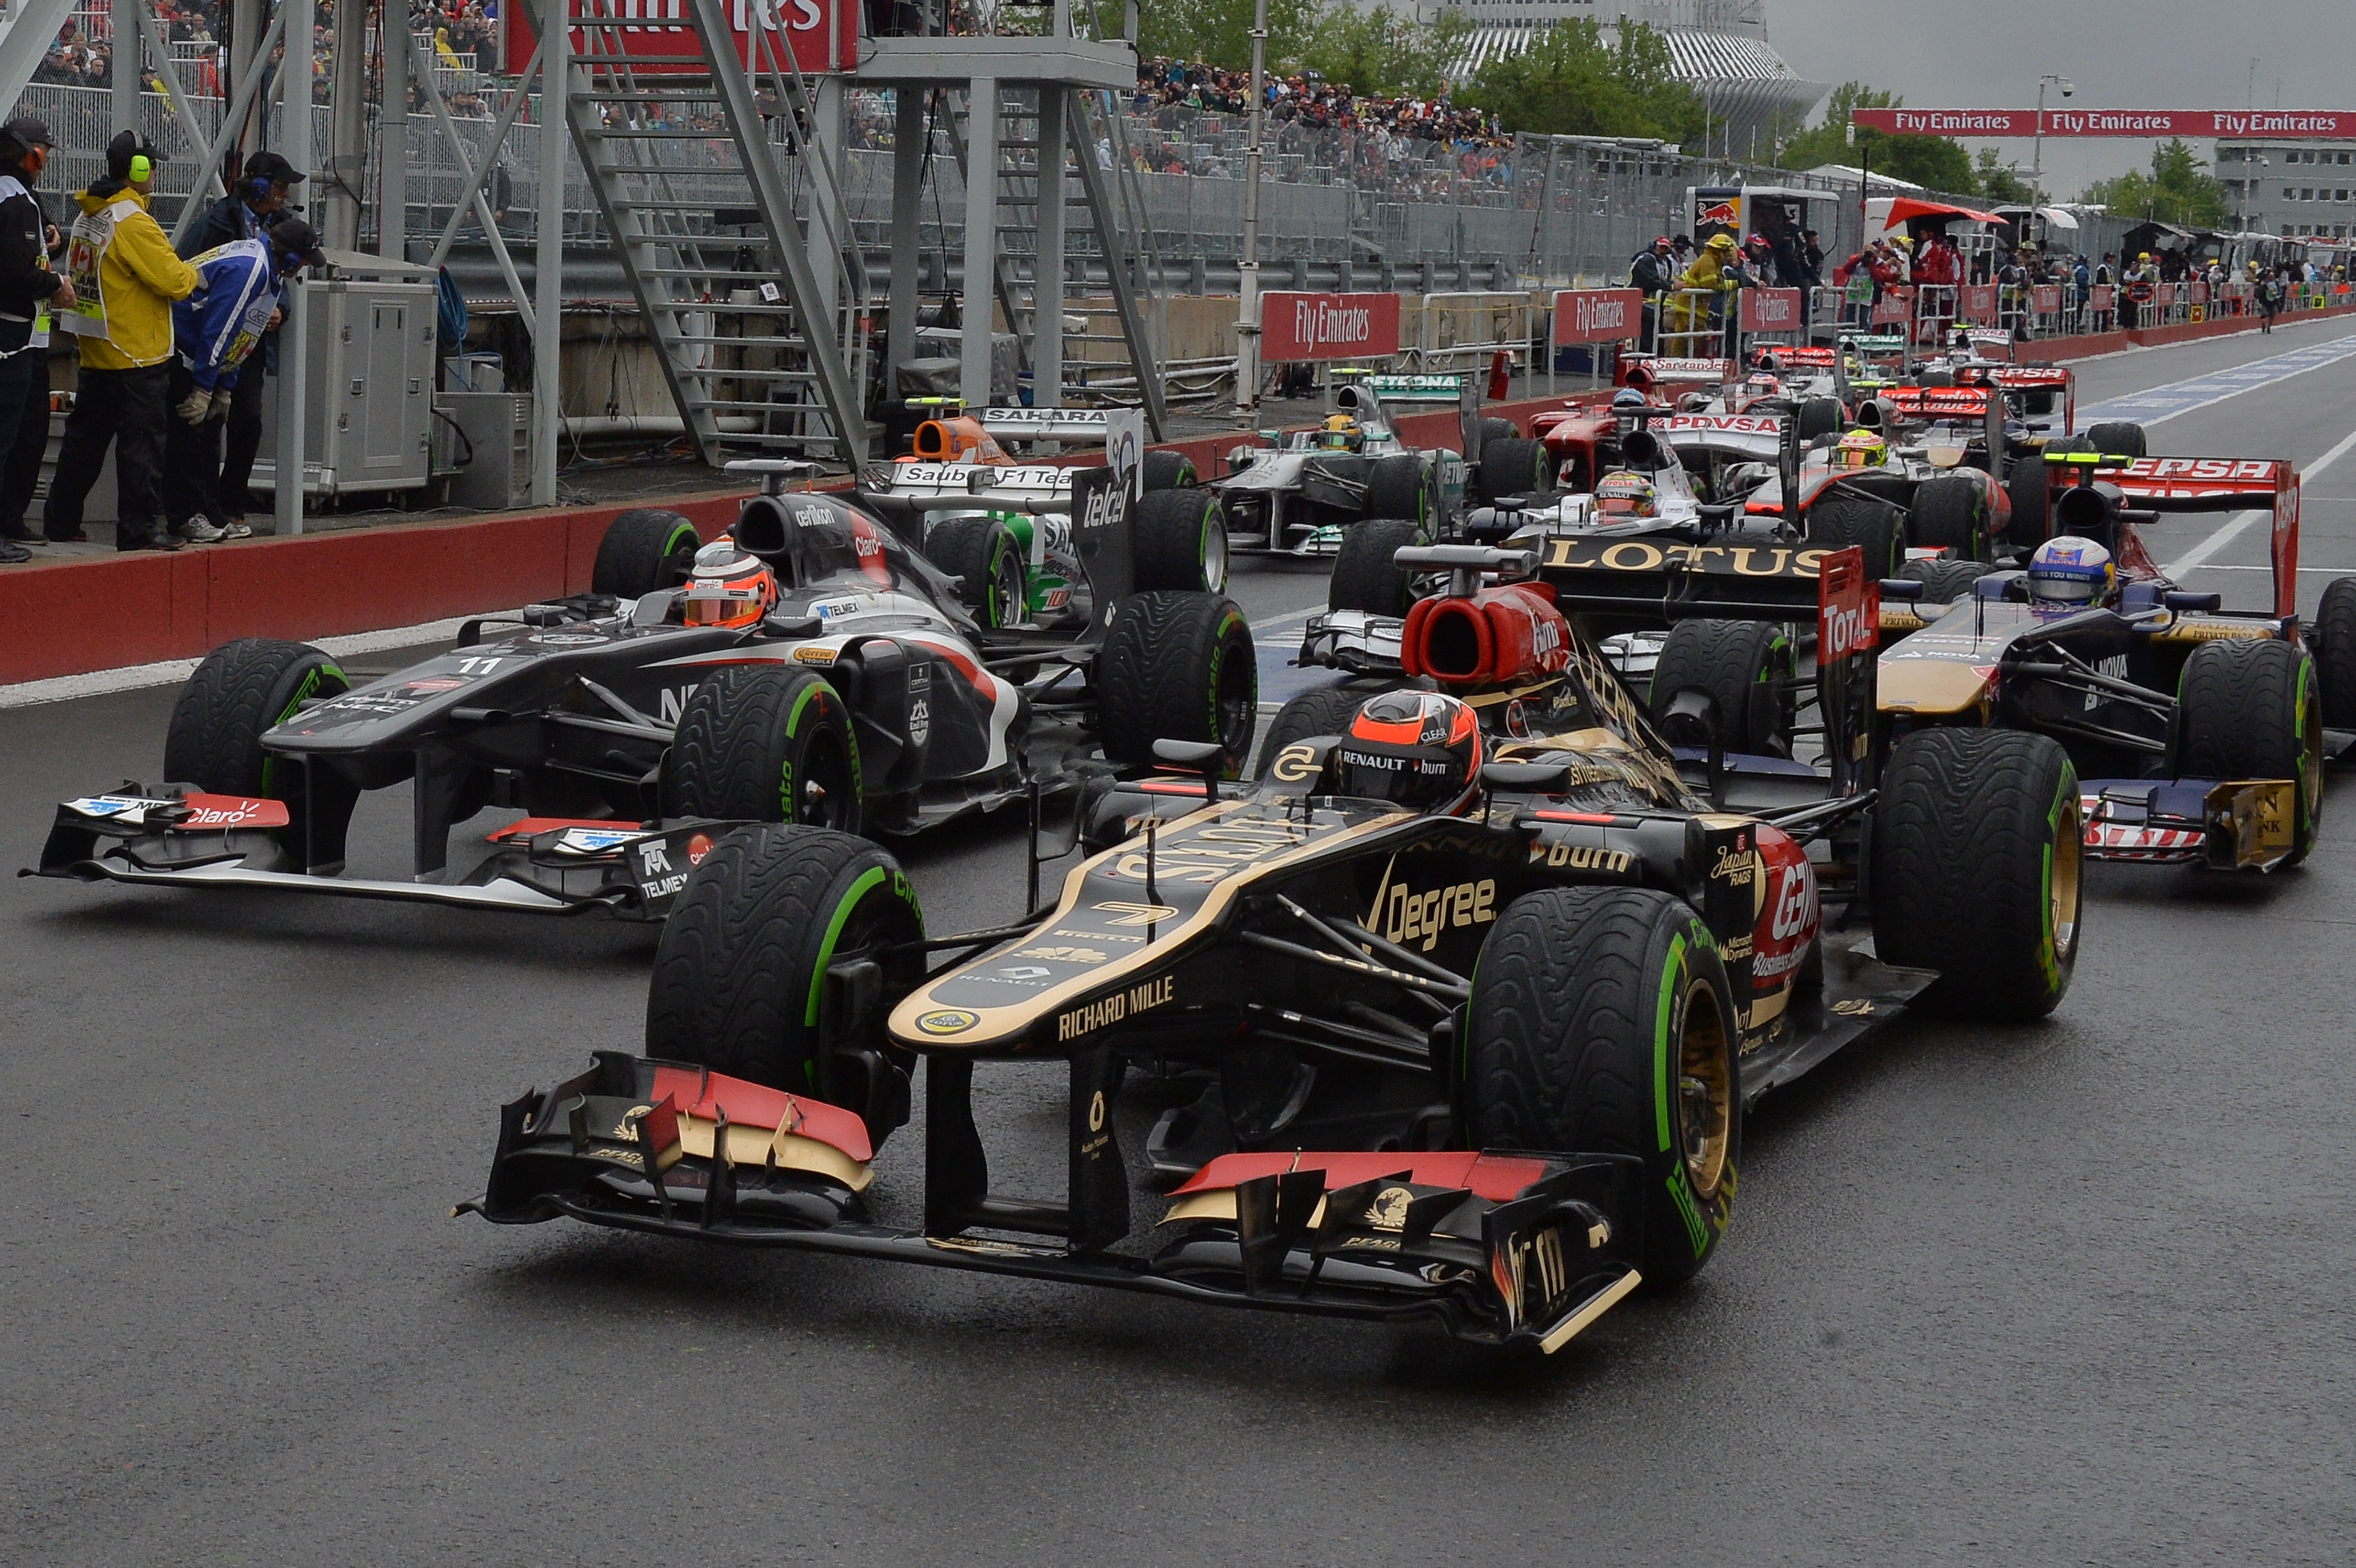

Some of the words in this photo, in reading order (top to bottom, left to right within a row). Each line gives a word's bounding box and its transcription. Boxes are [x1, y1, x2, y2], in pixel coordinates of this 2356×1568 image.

[1896, 113, 1926, 131] Fly
[1931, 113, 2010, 129] Emirates
[2052, 114, 2083, 132] Fly
[2088, 113, 2171, 130] Emirates
[2214, 114, 2247, 134] Fly
[2250, 114, 2336, 130] Emirates
[1576, 297, 1590, 338] Fly
[1591, 294, 1624, 330] Emirates
[1295, 301, 1316, 353] Fly
[1318, 301, 1369, 343] Emirates
[987, 410, 1108, 421] SAHARA
[1670, 416, 1781, 431] PDVSA
[1003, 471, 1027, 483] F1
[1035, 471, 1072, 484] Tea
[1083, 482, 1130, 528] telcel
[1543, 540, 1820, 577] LOTUS
[829, 603, 859, 617] TELMEX
[1824, 603, 1871, 654] TOTAL
[2193, 631, 2232, 640] PRIVATE
[459, 656, 502, 675] 11
[661, 686, 699, 724] N
[1420, 728, 1447, 743] CLEAR
[1343, 751, 1406, 771] RENAULT
[780, 760, 793, 824] ato
[1548, 839, 1628, 873] burn
[1710, 846, 1754, 880] Japan
[1730, 870, 1751, 887] RAGS
[1058, 993, 1126, 1042] RICHARD
[1129, 976, 1174, 1015] MILLE
